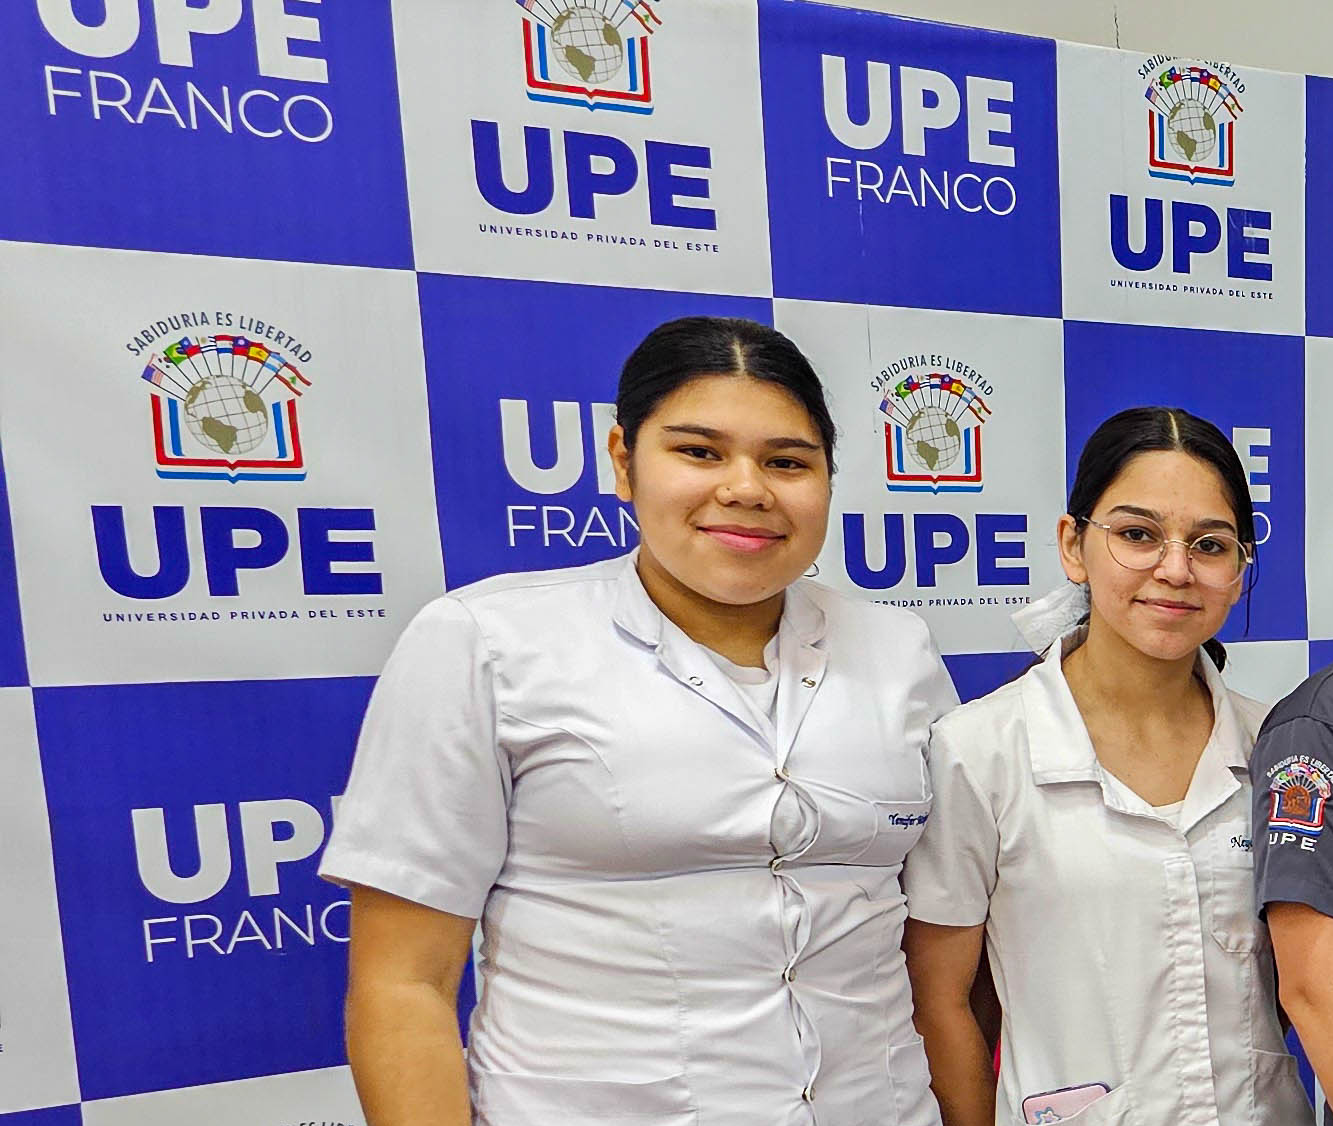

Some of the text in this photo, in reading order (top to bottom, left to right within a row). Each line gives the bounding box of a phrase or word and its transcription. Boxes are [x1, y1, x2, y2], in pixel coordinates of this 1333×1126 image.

[37, 0, 329, 84] UPE
[45, 65, 333, 143] FRANCO
[822, 53, 1015, 168] UPE
[471, 119, 718, 231] UPE
[826, 156, 1017, 216] FRANCO
[479, 223, 720, 253] UNIVERSIDAD PRIVADA DEL ESTE
[1110, 193, 1273, 282] UPE
[1110, 279, 1273, 301] UNIVERSIDAD PRIVADA DEL ESTE
[126, 311, 313, 364] SABIDURIA ES LIBERTAD
[870, 354, 994, 397] SABIDURIA ES LIBERTAD
[90, 504, 384, 600] UPE
[507, 505, 641, 548] FRAN
[842, 512, 1030, 590] UPE
[103, 608, 387, 623] UNIVERSIDAD PRIVADA DEL ESTE
[929, 597, 974, 607] PRIVADA
[979, 597, 999, 606] DEL
[1005, 596, 1031, 605] ESTE
[131, 795, 345, 904] UP
[1269, 832, 1318, 853] UPE
[143, 900, 352, 963] FRANC
